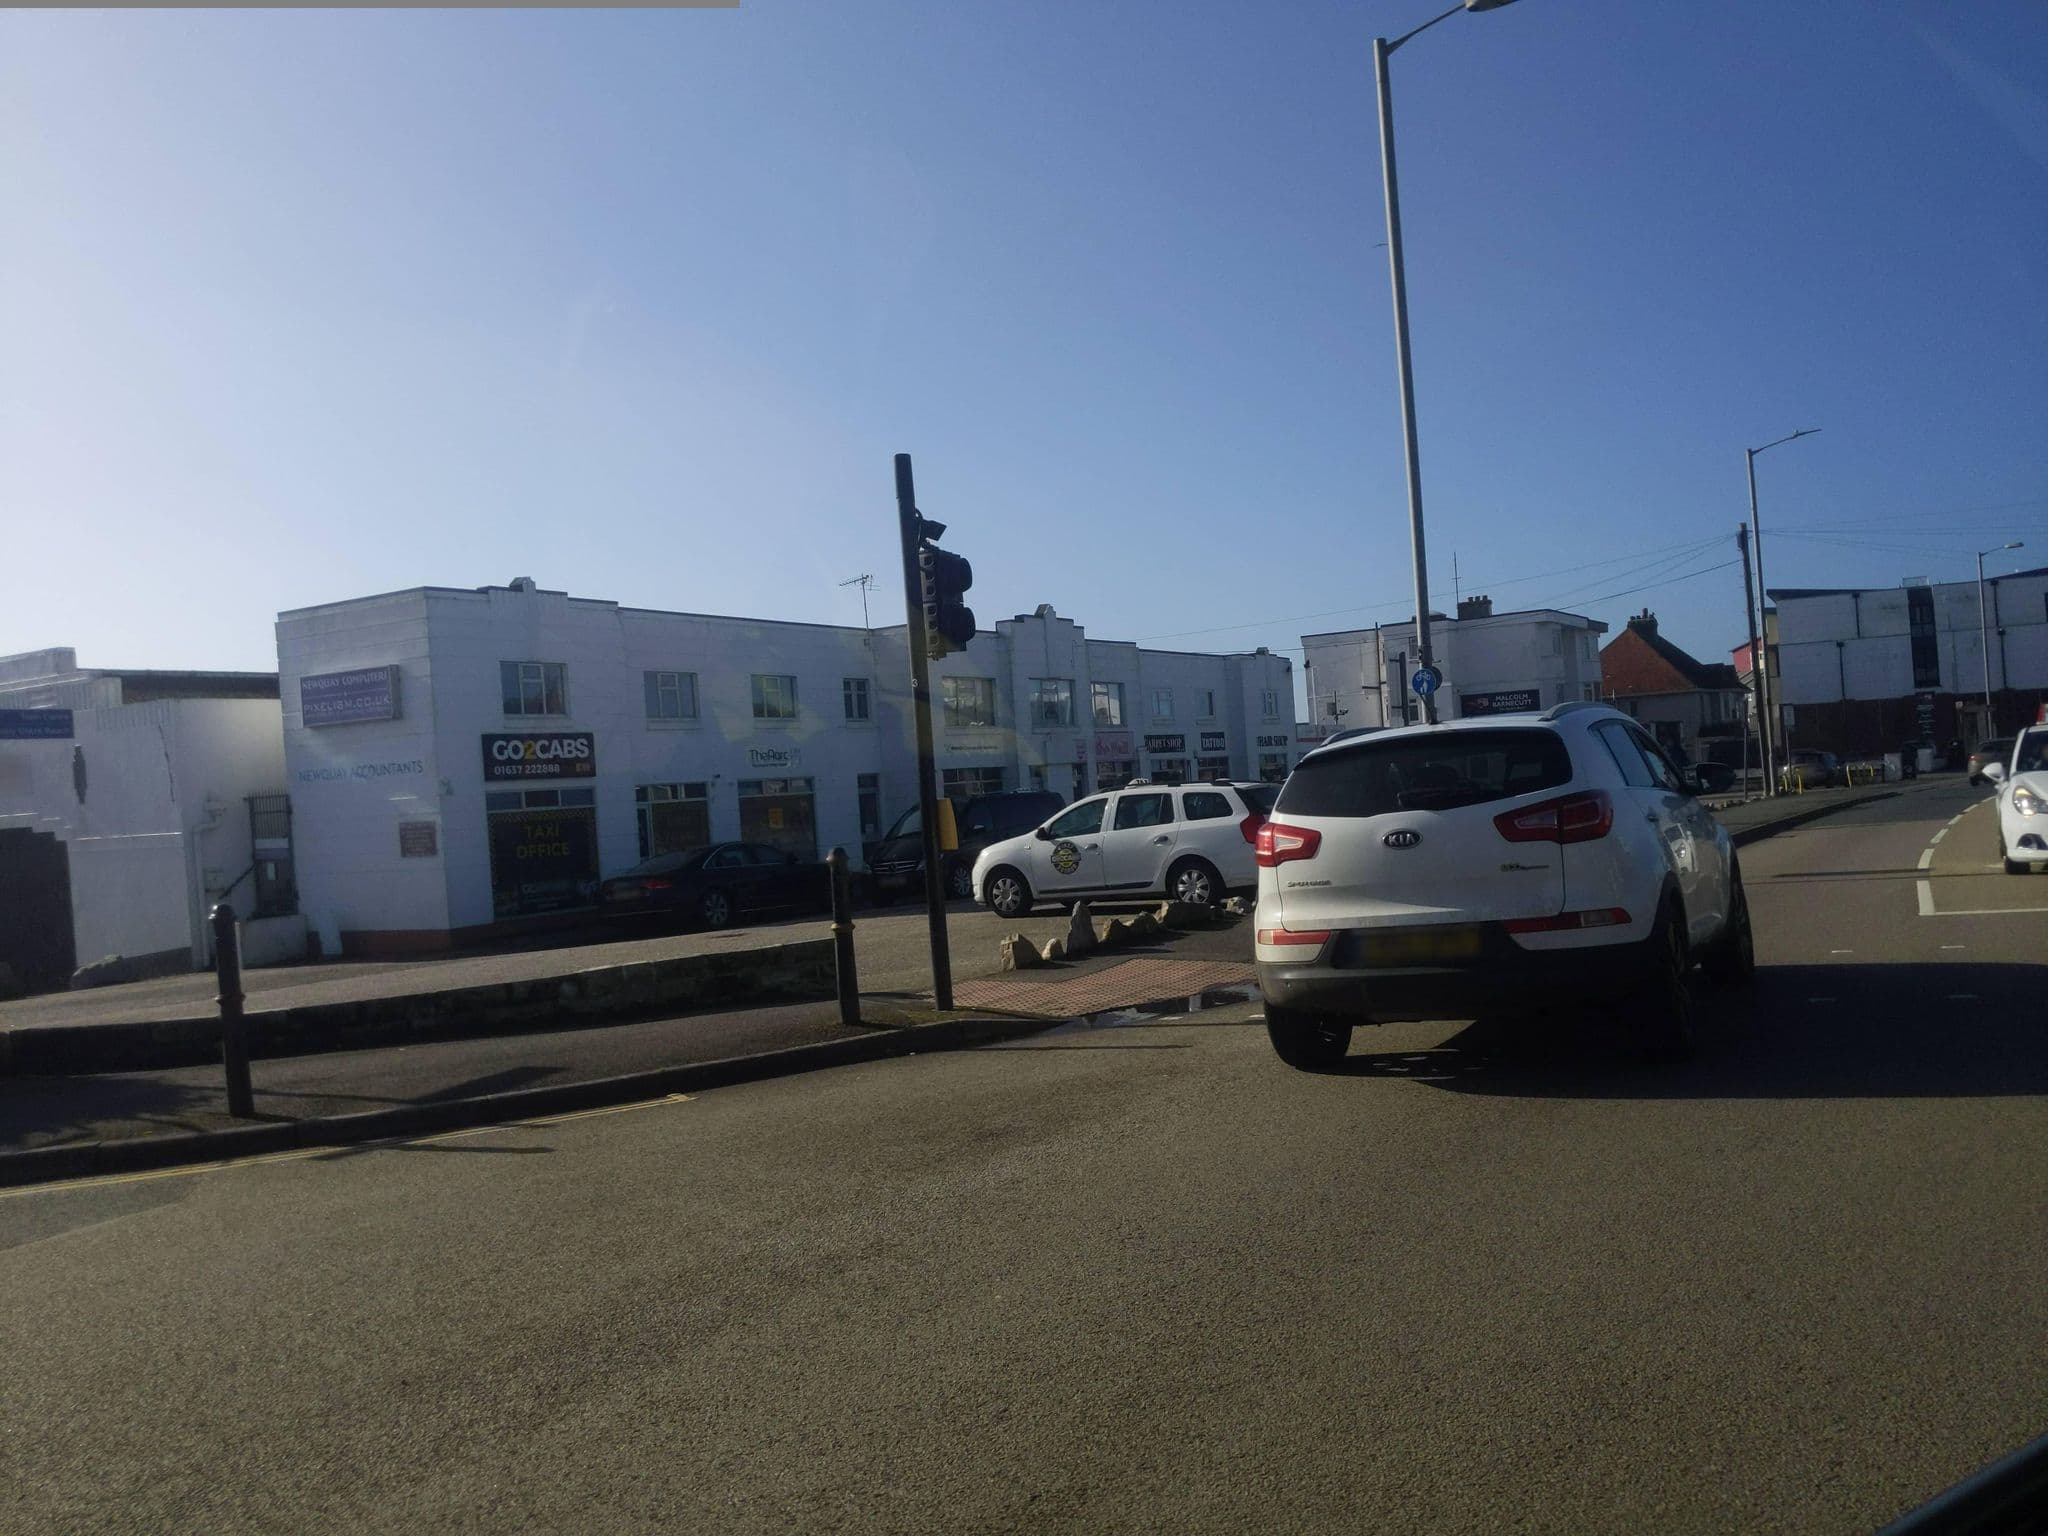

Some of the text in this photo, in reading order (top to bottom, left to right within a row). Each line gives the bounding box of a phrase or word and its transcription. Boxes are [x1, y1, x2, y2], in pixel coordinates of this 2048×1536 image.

[303, 678, 340, 690] NEWQUAY
[1495, 693, 1529, 701] MALCOLM
[1202, 737, 1225, 748] TATTOO
[493, 738, 590, 760] GO2CABS
[494, 765, 522, 775] 01637
[524, 822, 560, 839] TAXI
[1388, 833, 1416, 846] KIA
[515, 842, 570, 859] OFFICE
